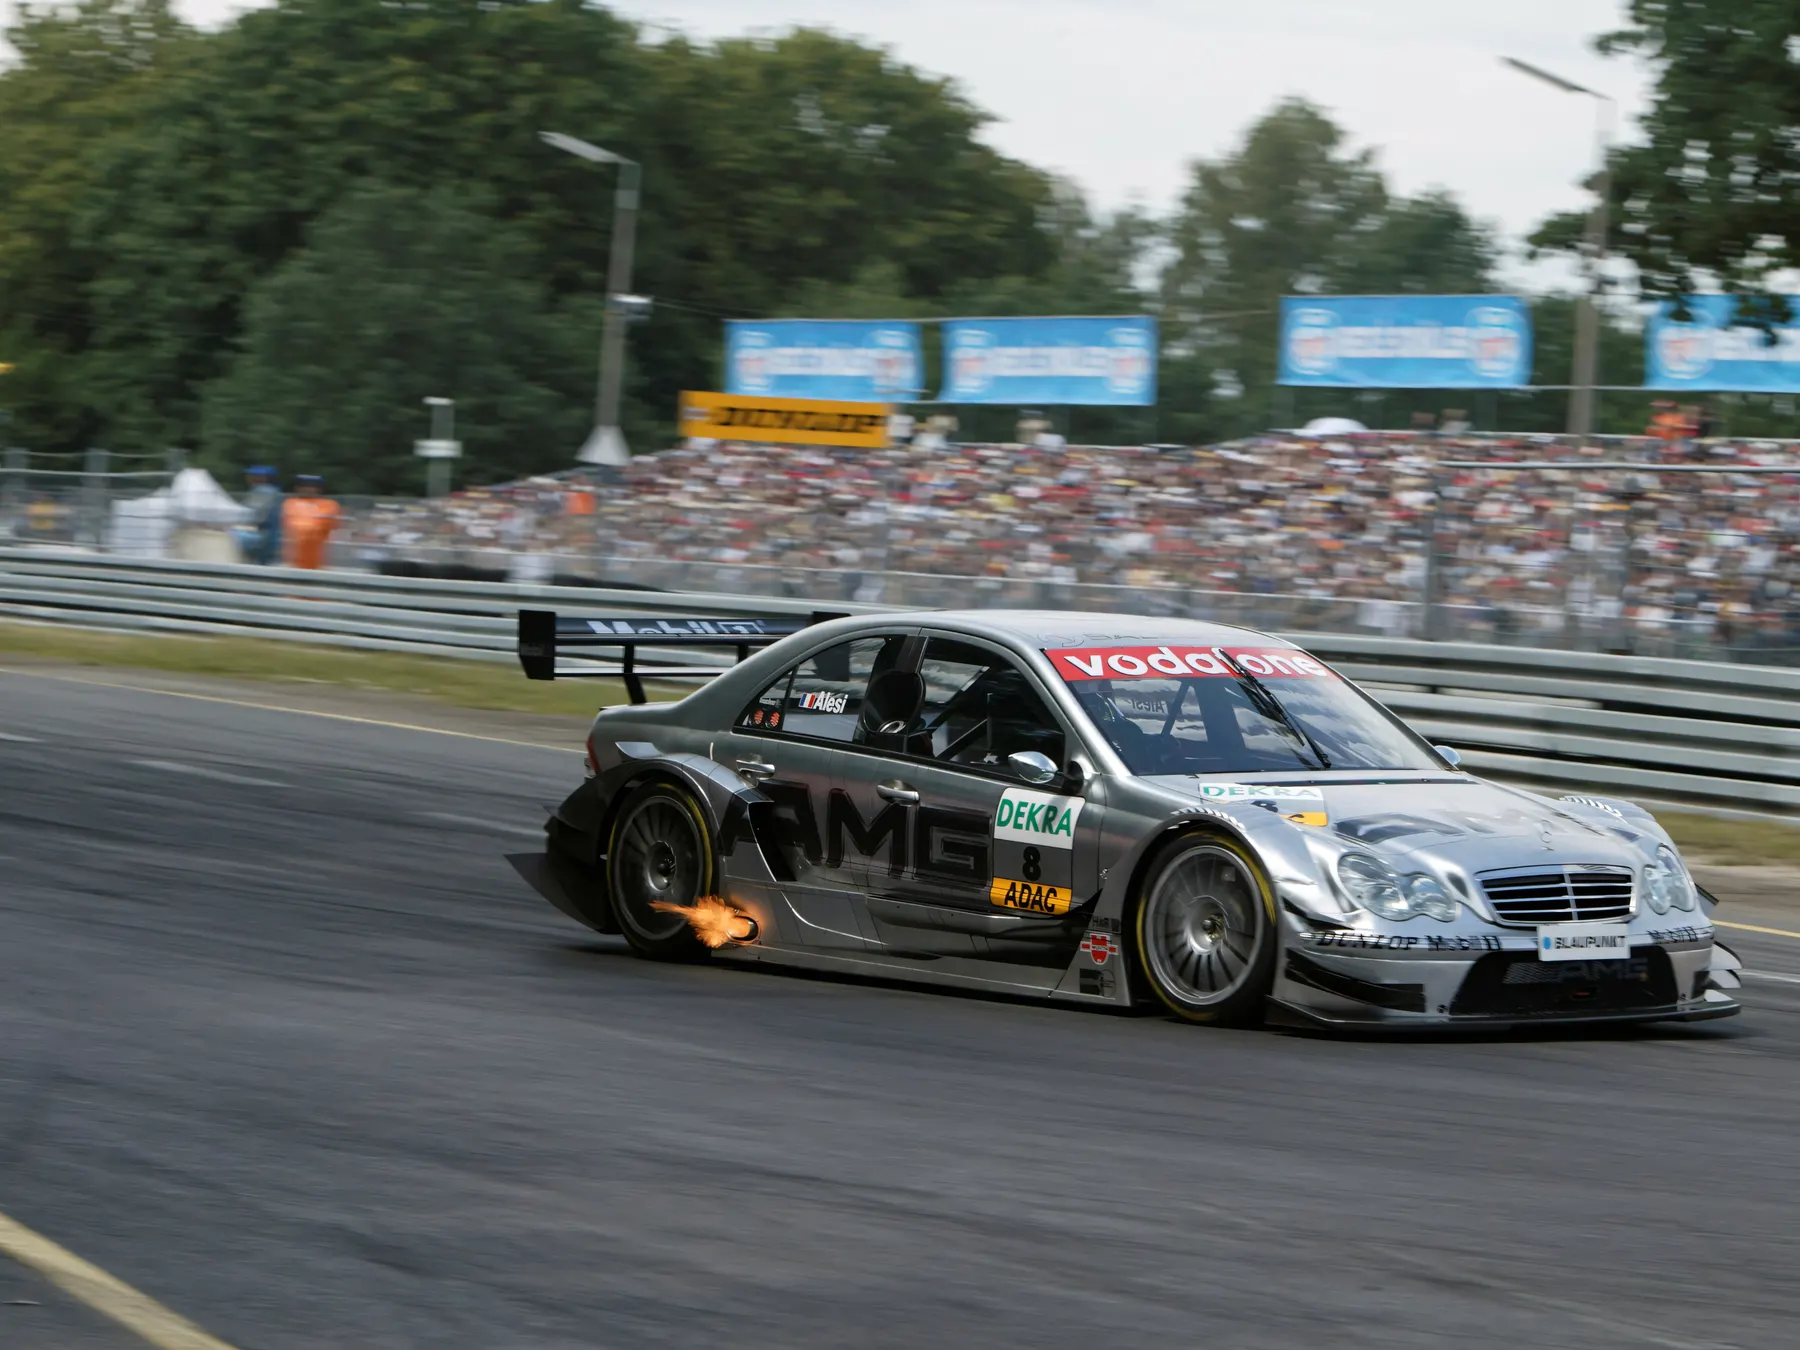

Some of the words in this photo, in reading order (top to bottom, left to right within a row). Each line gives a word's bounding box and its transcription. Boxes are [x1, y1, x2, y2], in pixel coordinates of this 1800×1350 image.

[1064, 647, 1327, 677] vodafone
[813, 690, 849, 714] Alesi
[1203, 785, 1318, 798] DEKRA
[996, 798, 1071, 837] DEKRA
[720, 779, 993, 889] AMG
[1022, 846, 1041, 881] 8
[1004, 882, 1058, 913] ADAC
[1555, 935, 1626, 949] BLAUPUNKT
